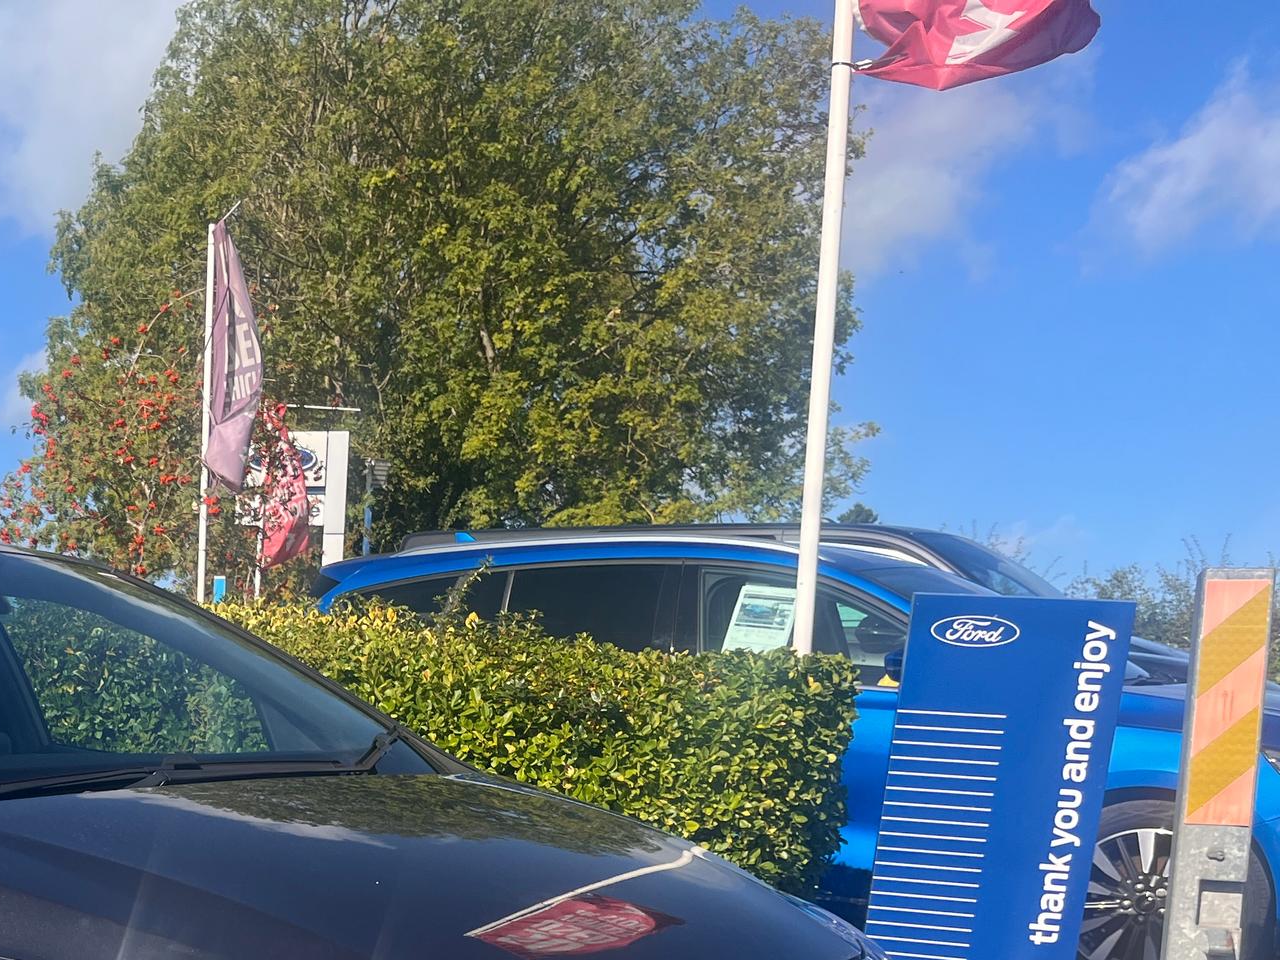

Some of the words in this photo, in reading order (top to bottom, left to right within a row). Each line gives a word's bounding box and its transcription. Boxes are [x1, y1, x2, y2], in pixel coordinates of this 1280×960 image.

[945, 619, 1004, 642] Ford
[1073, 620, 1117, 712] enjoy
[1062, 718, 1096, 782] and
[1050, 788, 1083, 847] you
[1028, 852, 1072, 945] thank
